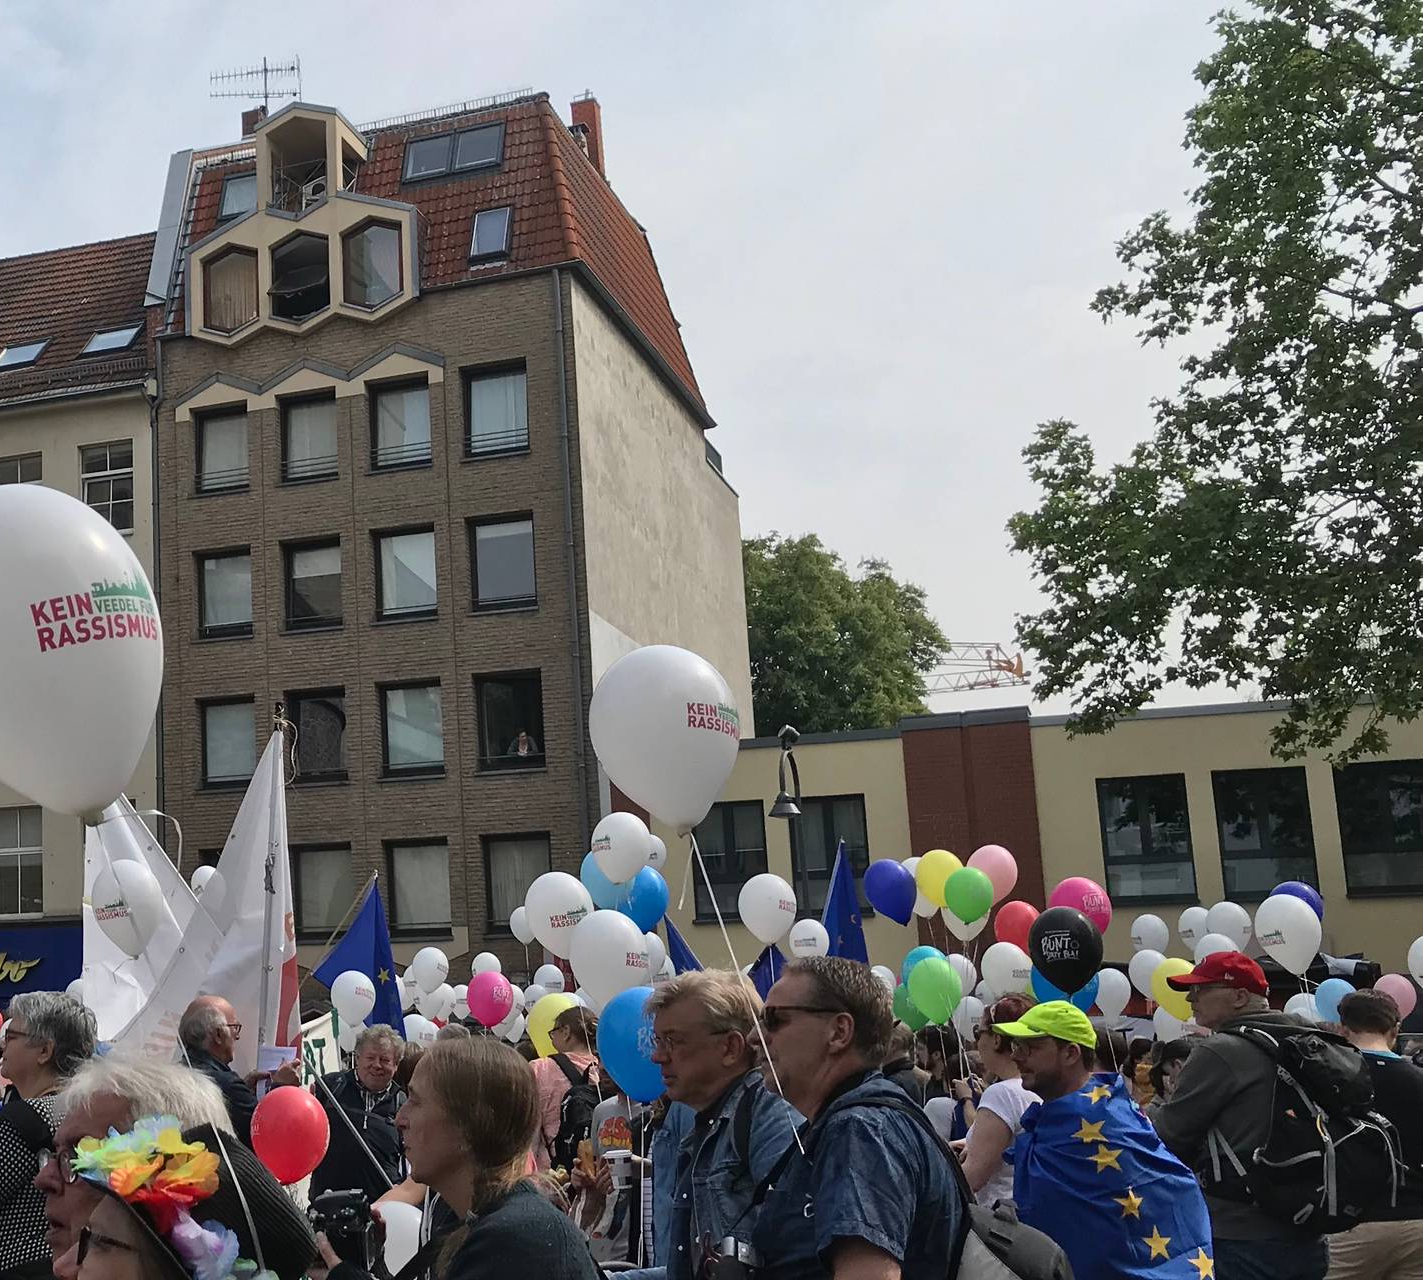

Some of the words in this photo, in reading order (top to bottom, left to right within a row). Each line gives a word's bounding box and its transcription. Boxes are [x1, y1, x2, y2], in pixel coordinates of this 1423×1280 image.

[30, 592, 94, 627] KEIN
[94, 598, 138, 613] VEEDEL
[37, 613, 157, 653] RASSISMUS
[686, 702, 718, 717] KEIN
[550, 913, 567, 922] KEIN
[551, 918, 579, 929] RASSIS
